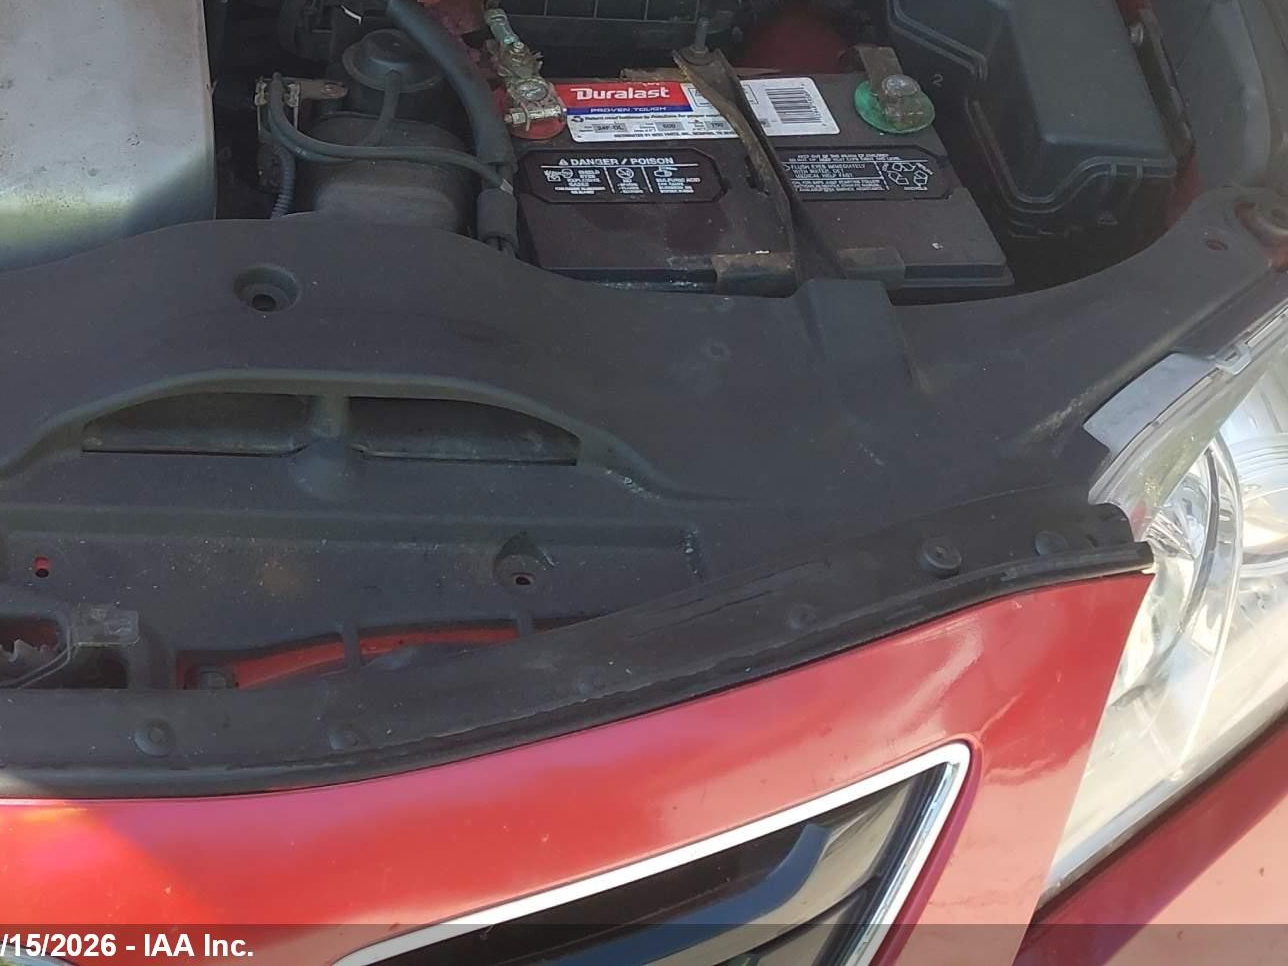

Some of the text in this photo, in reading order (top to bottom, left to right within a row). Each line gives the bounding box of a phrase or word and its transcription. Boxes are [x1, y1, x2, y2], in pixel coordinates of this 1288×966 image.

[570, 86, 670, 101] Duralast
[570, 158, 619, 166] DANGER
[630, 157, 675, 165] POISON
